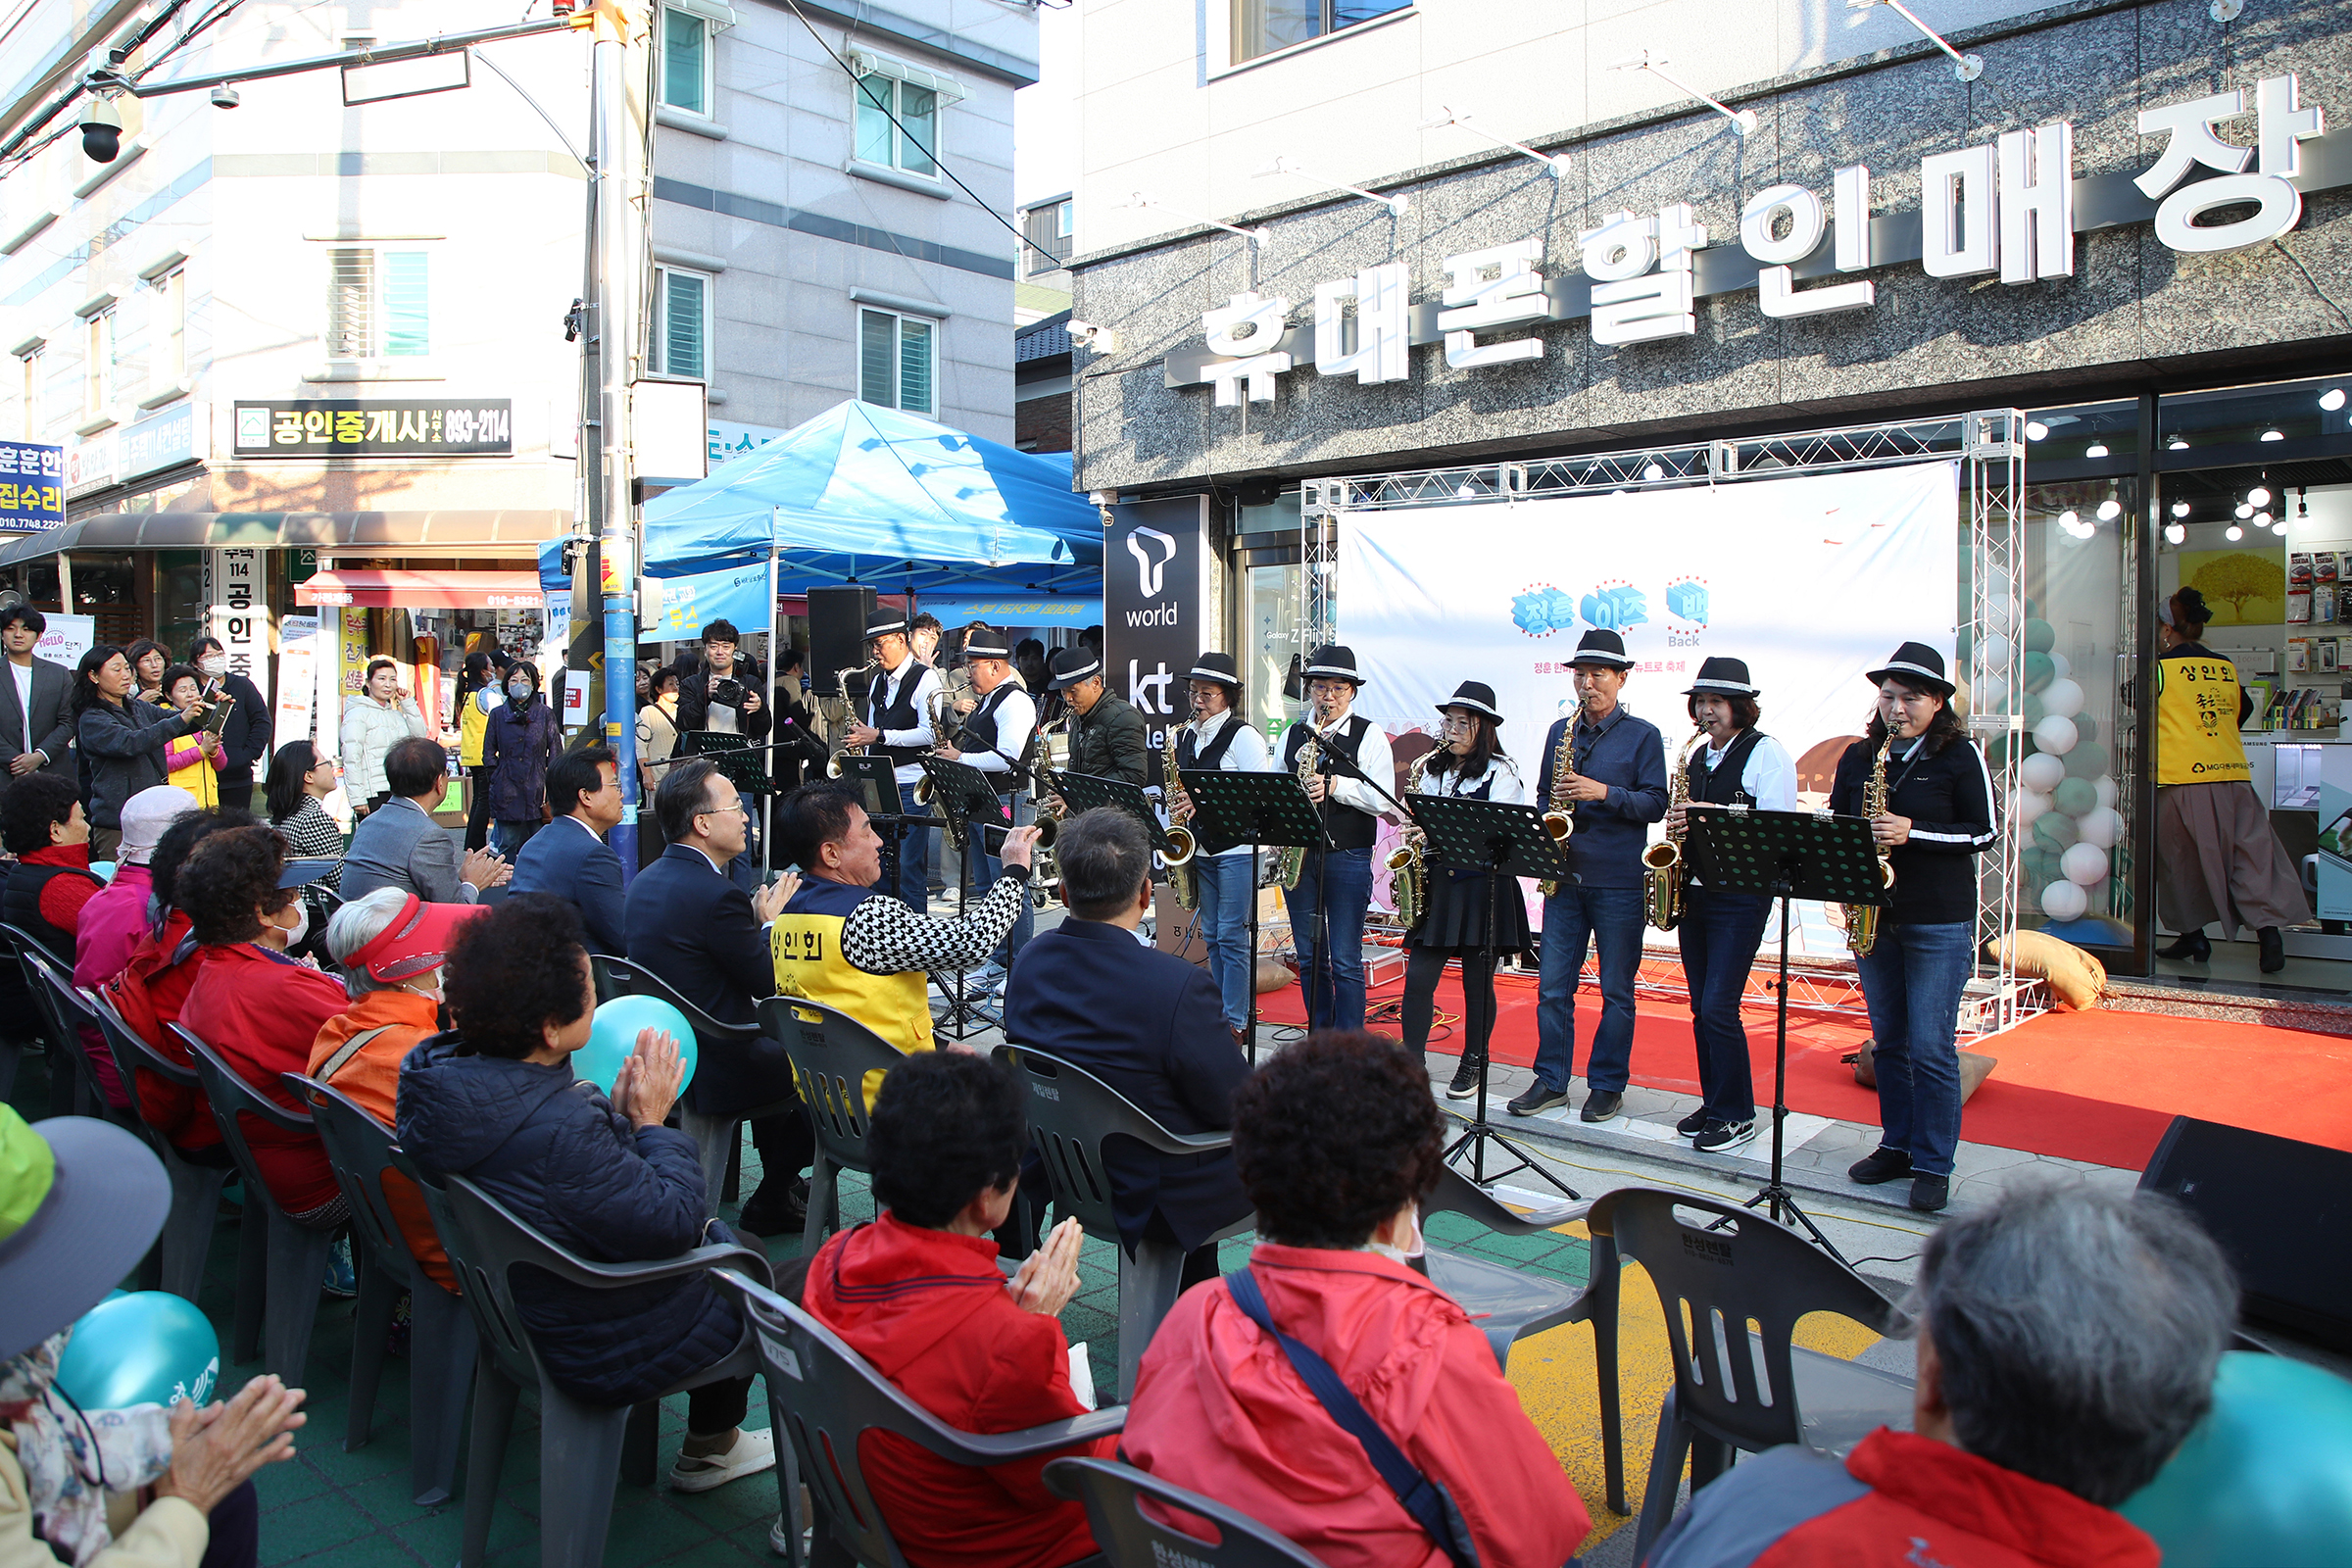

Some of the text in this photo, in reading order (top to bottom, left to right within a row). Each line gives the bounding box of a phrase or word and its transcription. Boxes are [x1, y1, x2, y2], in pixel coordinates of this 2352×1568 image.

[273, 410, 429, 444] 공인중개사
[445, 409, 509, 443] 893-2114
[0, 446, 62, 477] 훈훈한
[0, 483, 62, 513] 집수리
[229, 563, 249, 576] 114
[669, 606, 699, 631] 부스
[1126, 602, 1178, 627] world
[1513, 590, 1575, 634] 정훈
[1667, 584, 1709, 625] 백
[1266, 631, 1290, 641] Galaxy
[1290, 628, 1299, 644] Z
[1668, 636, 1700, 647] Back
[1534, 662, 1551, 674] 정훈
[1635, 662, 1663, 673] 뉴트로
[1666, 661, 1686, 672] 축제
[2180, 664, 2234, 683] 상인회
[1129, 659, 1174, 714] kt
[772, 930, 822, 961] 상인회
